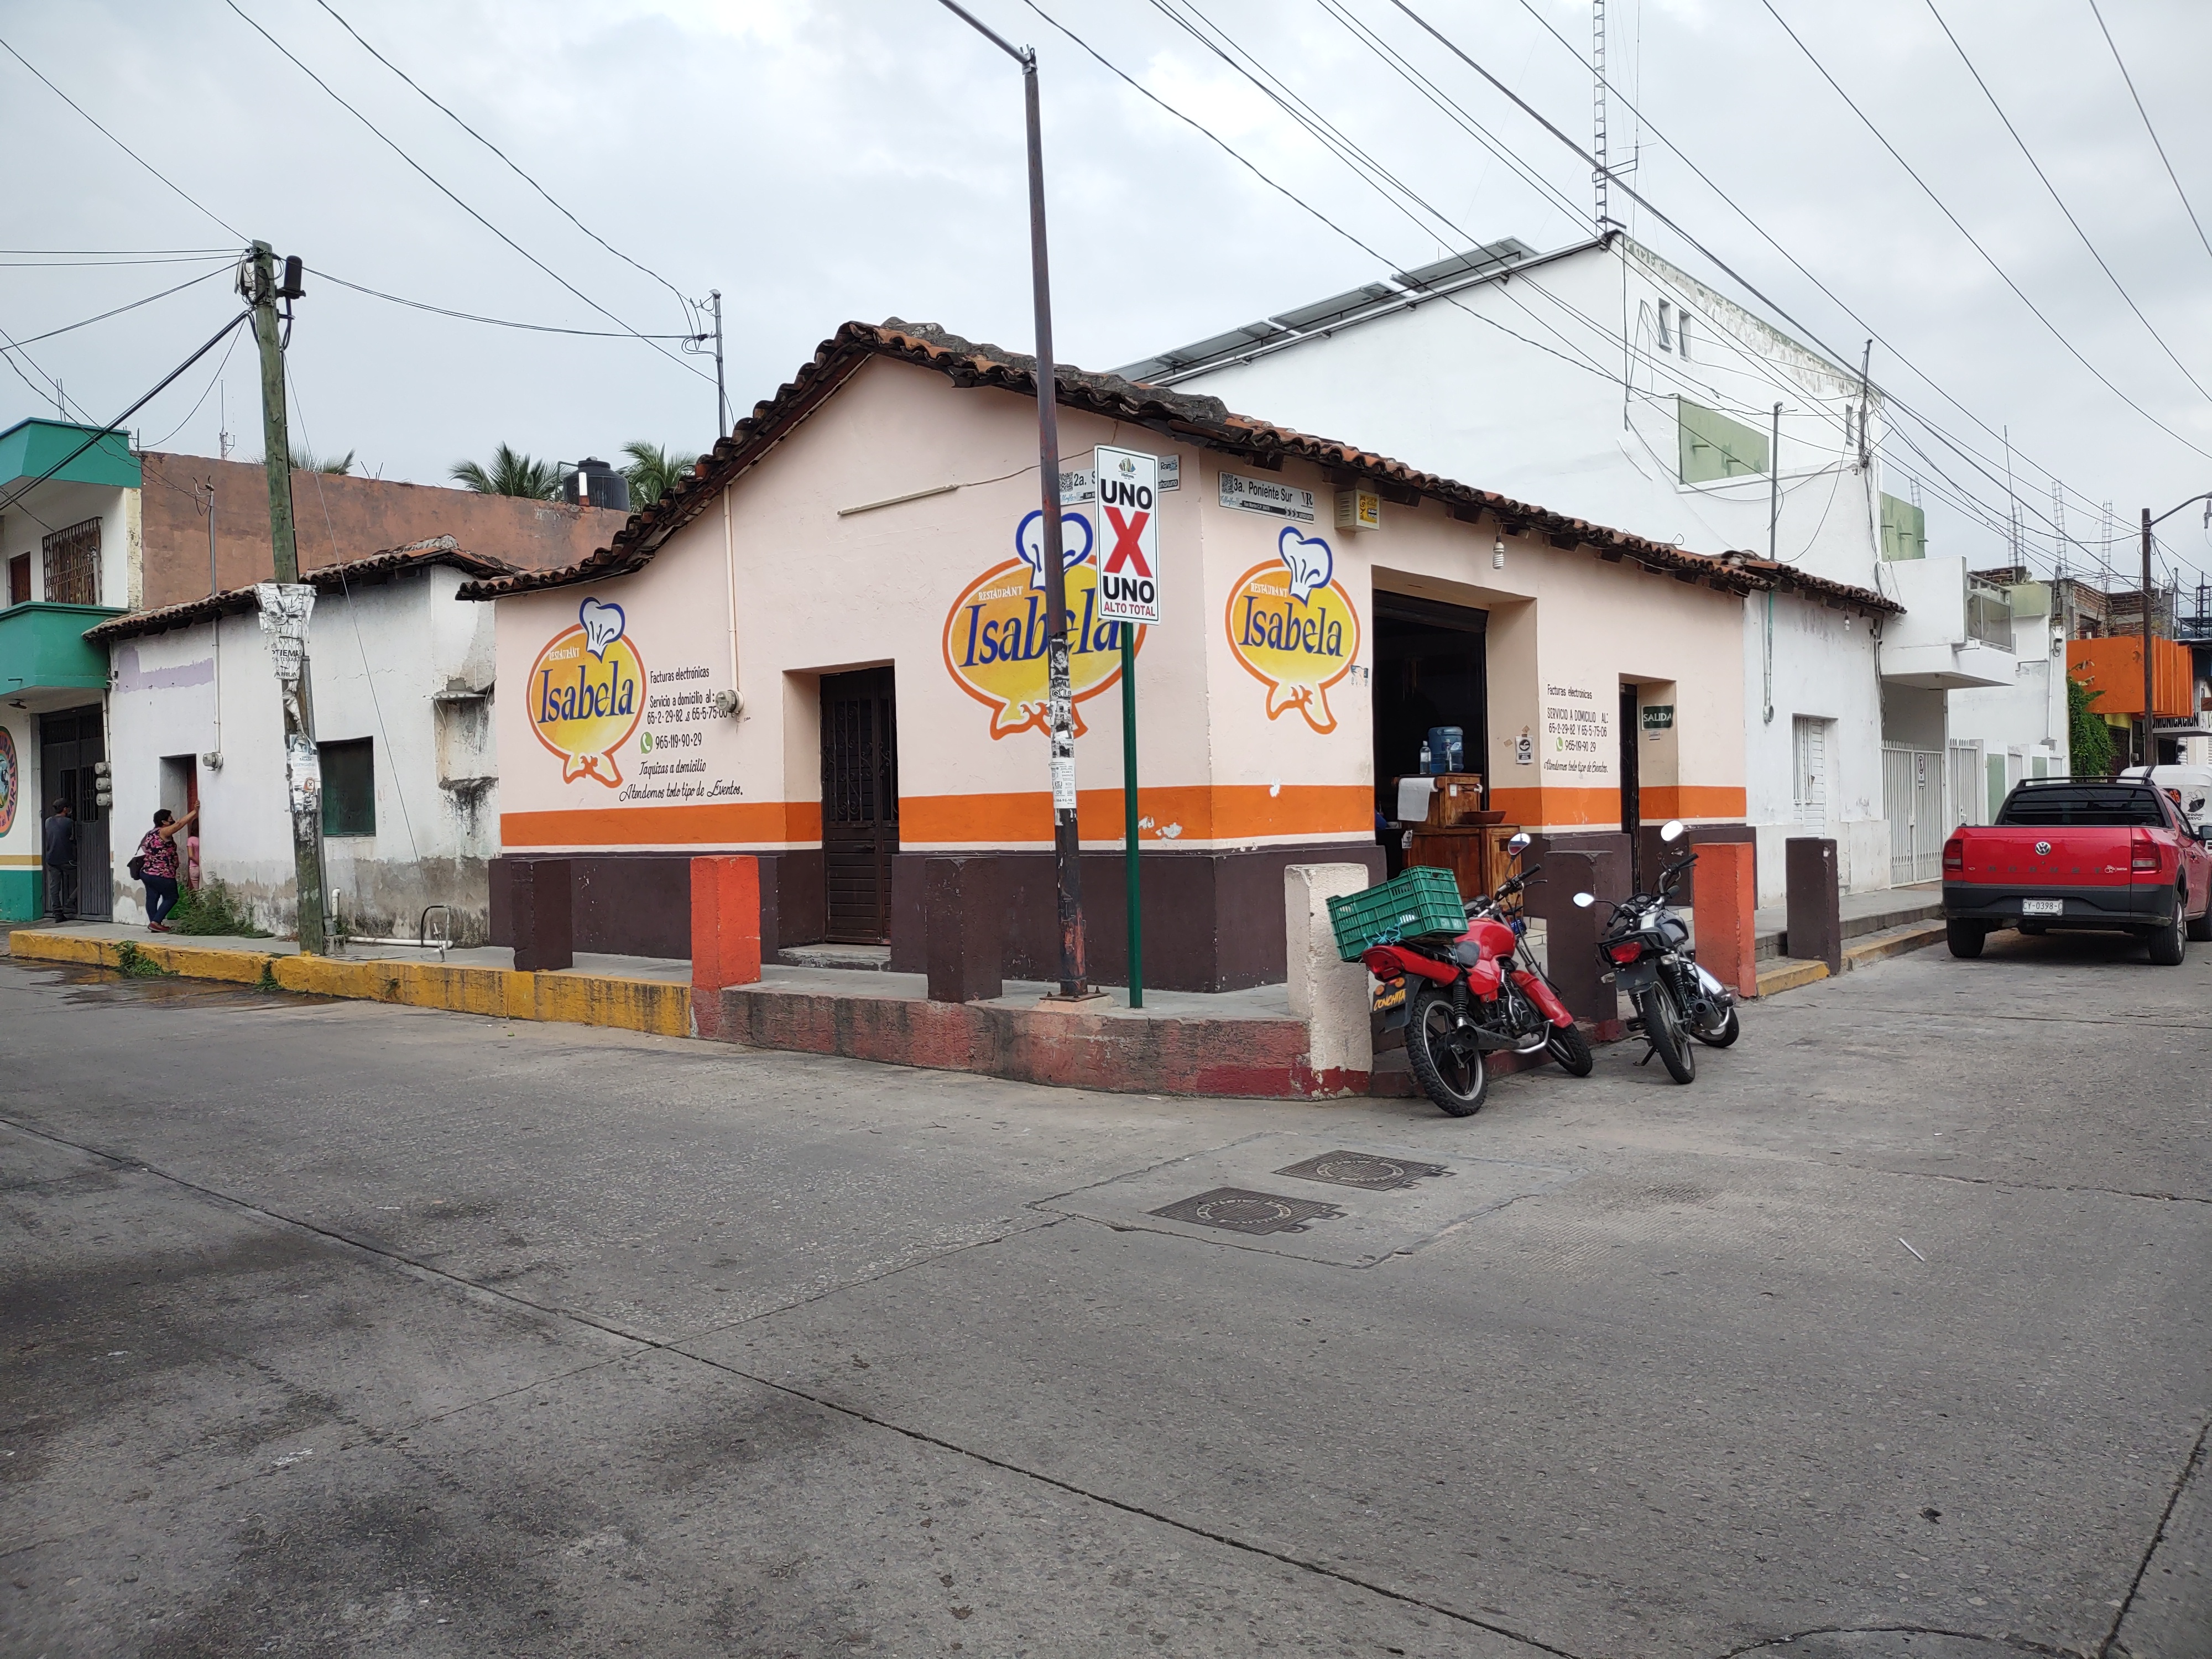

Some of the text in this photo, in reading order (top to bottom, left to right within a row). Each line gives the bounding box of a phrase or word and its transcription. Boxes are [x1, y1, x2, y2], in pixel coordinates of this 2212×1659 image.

[1074, 473, 1086, 486] 2a.
[1100, 478, 1152, 510] UNO
[1233, 478, 1293, 503] 3a. Poniente Sur
[1102, 505, 1153, 578] X
[978, 586, 1022, 602] RESTAURANT
[1103, 576, 1155, 604] UNO
[1250, 582, 1287, 598] RESTAURANT
[1104, 601, 1156, 617] ALTO TOTAL
[1239, 595, 1344, 658] Isabela
[549, 646, 580, 661] RESTAURANT
[650, 666, 710, 684] Facturas electrónicas
[537, 660, 635, 723] Isabela
[650, 695, 670, 708] Servicio
[672, 697, 676, 706] a
[677, 690, 703, 705] domicilio
[1547, 684, 1592, 700] Facturas electrónicas
[1547, 707, 1568, 720] SERVICIO
[1570, 709, 1573, 721] A
[1574, 709, 1596, 723] DOMICILIO
[1643, 712, 1672, 722] SALIDA
[1577, 724, 1580, 735] Y
[639, 758, 706, 779] Taquizas a domicilio
[1543, 758, 1567, 770] Atendemos
[1568, 760, 1577, 771] todo
[1578, 761, 1586, 773] tipo
[1587, 761, 1592, 773] de
[619, 779, 743, 801] Atendemos todo tipo de Eventos.
[2023, 901, 2062, 910] CY-0398-C
[1374, 988, 1407, 1011] CONCHITA
